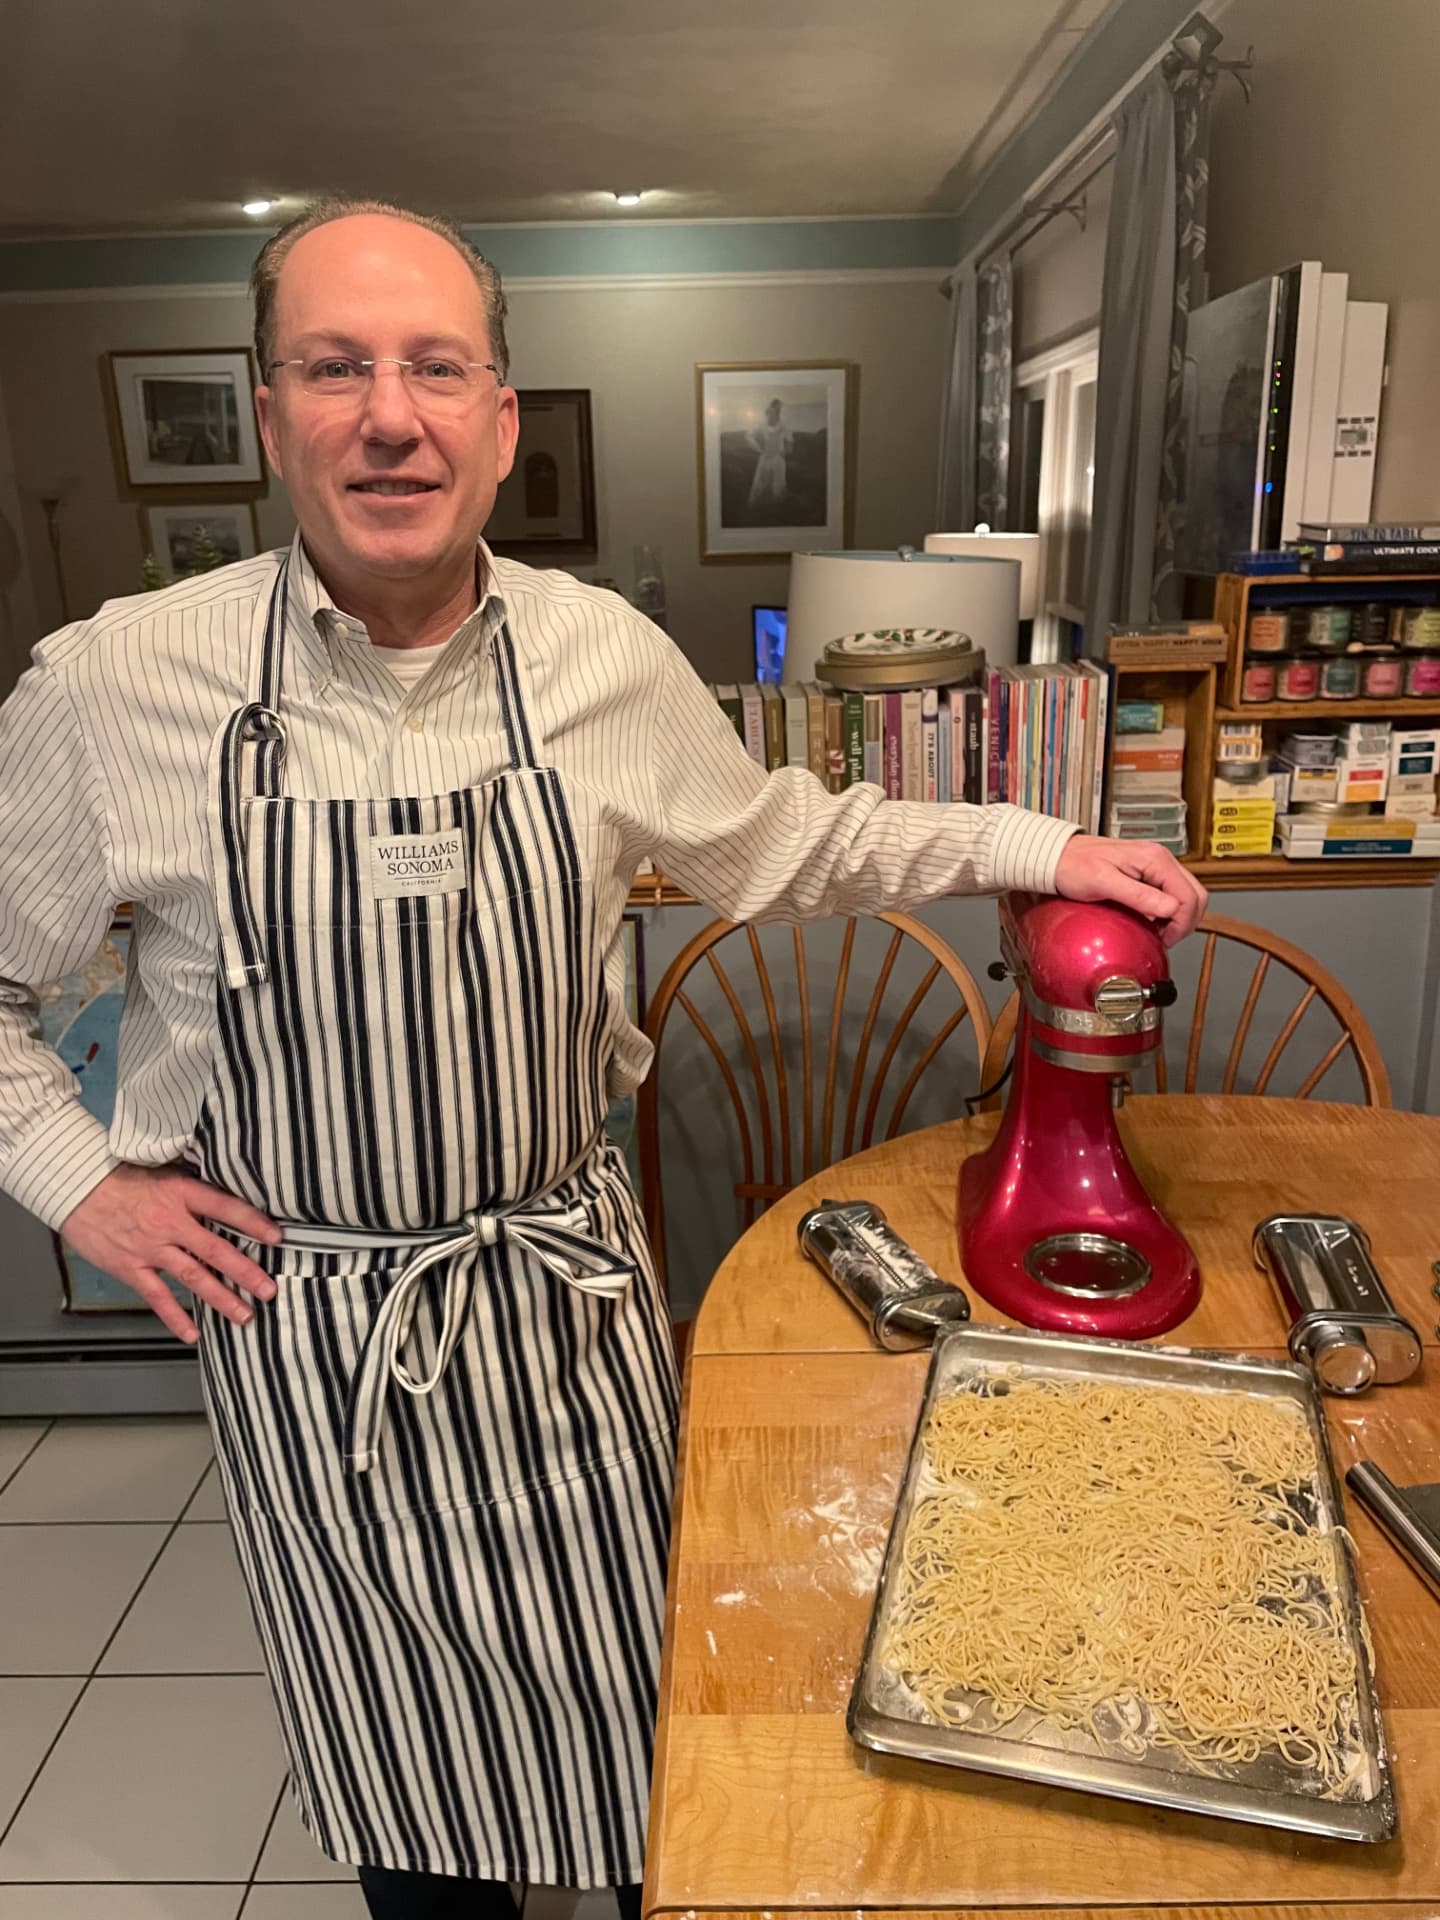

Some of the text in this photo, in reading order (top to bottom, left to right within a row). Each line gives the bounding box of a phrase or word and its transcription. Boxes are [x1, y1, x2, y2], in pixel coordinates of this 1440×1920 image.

[1373, 546, 1414, 555] ULTIMATE
[851, 731, 862, 755] well
[969, 722, 979, 750] staub
[990, 720, 1000, 767] VENICE
[888, 735, 900, 777] everyday
[377, 840, 459, 860] WILLIAMS
[387, 858, 454, 876] SONOMA
